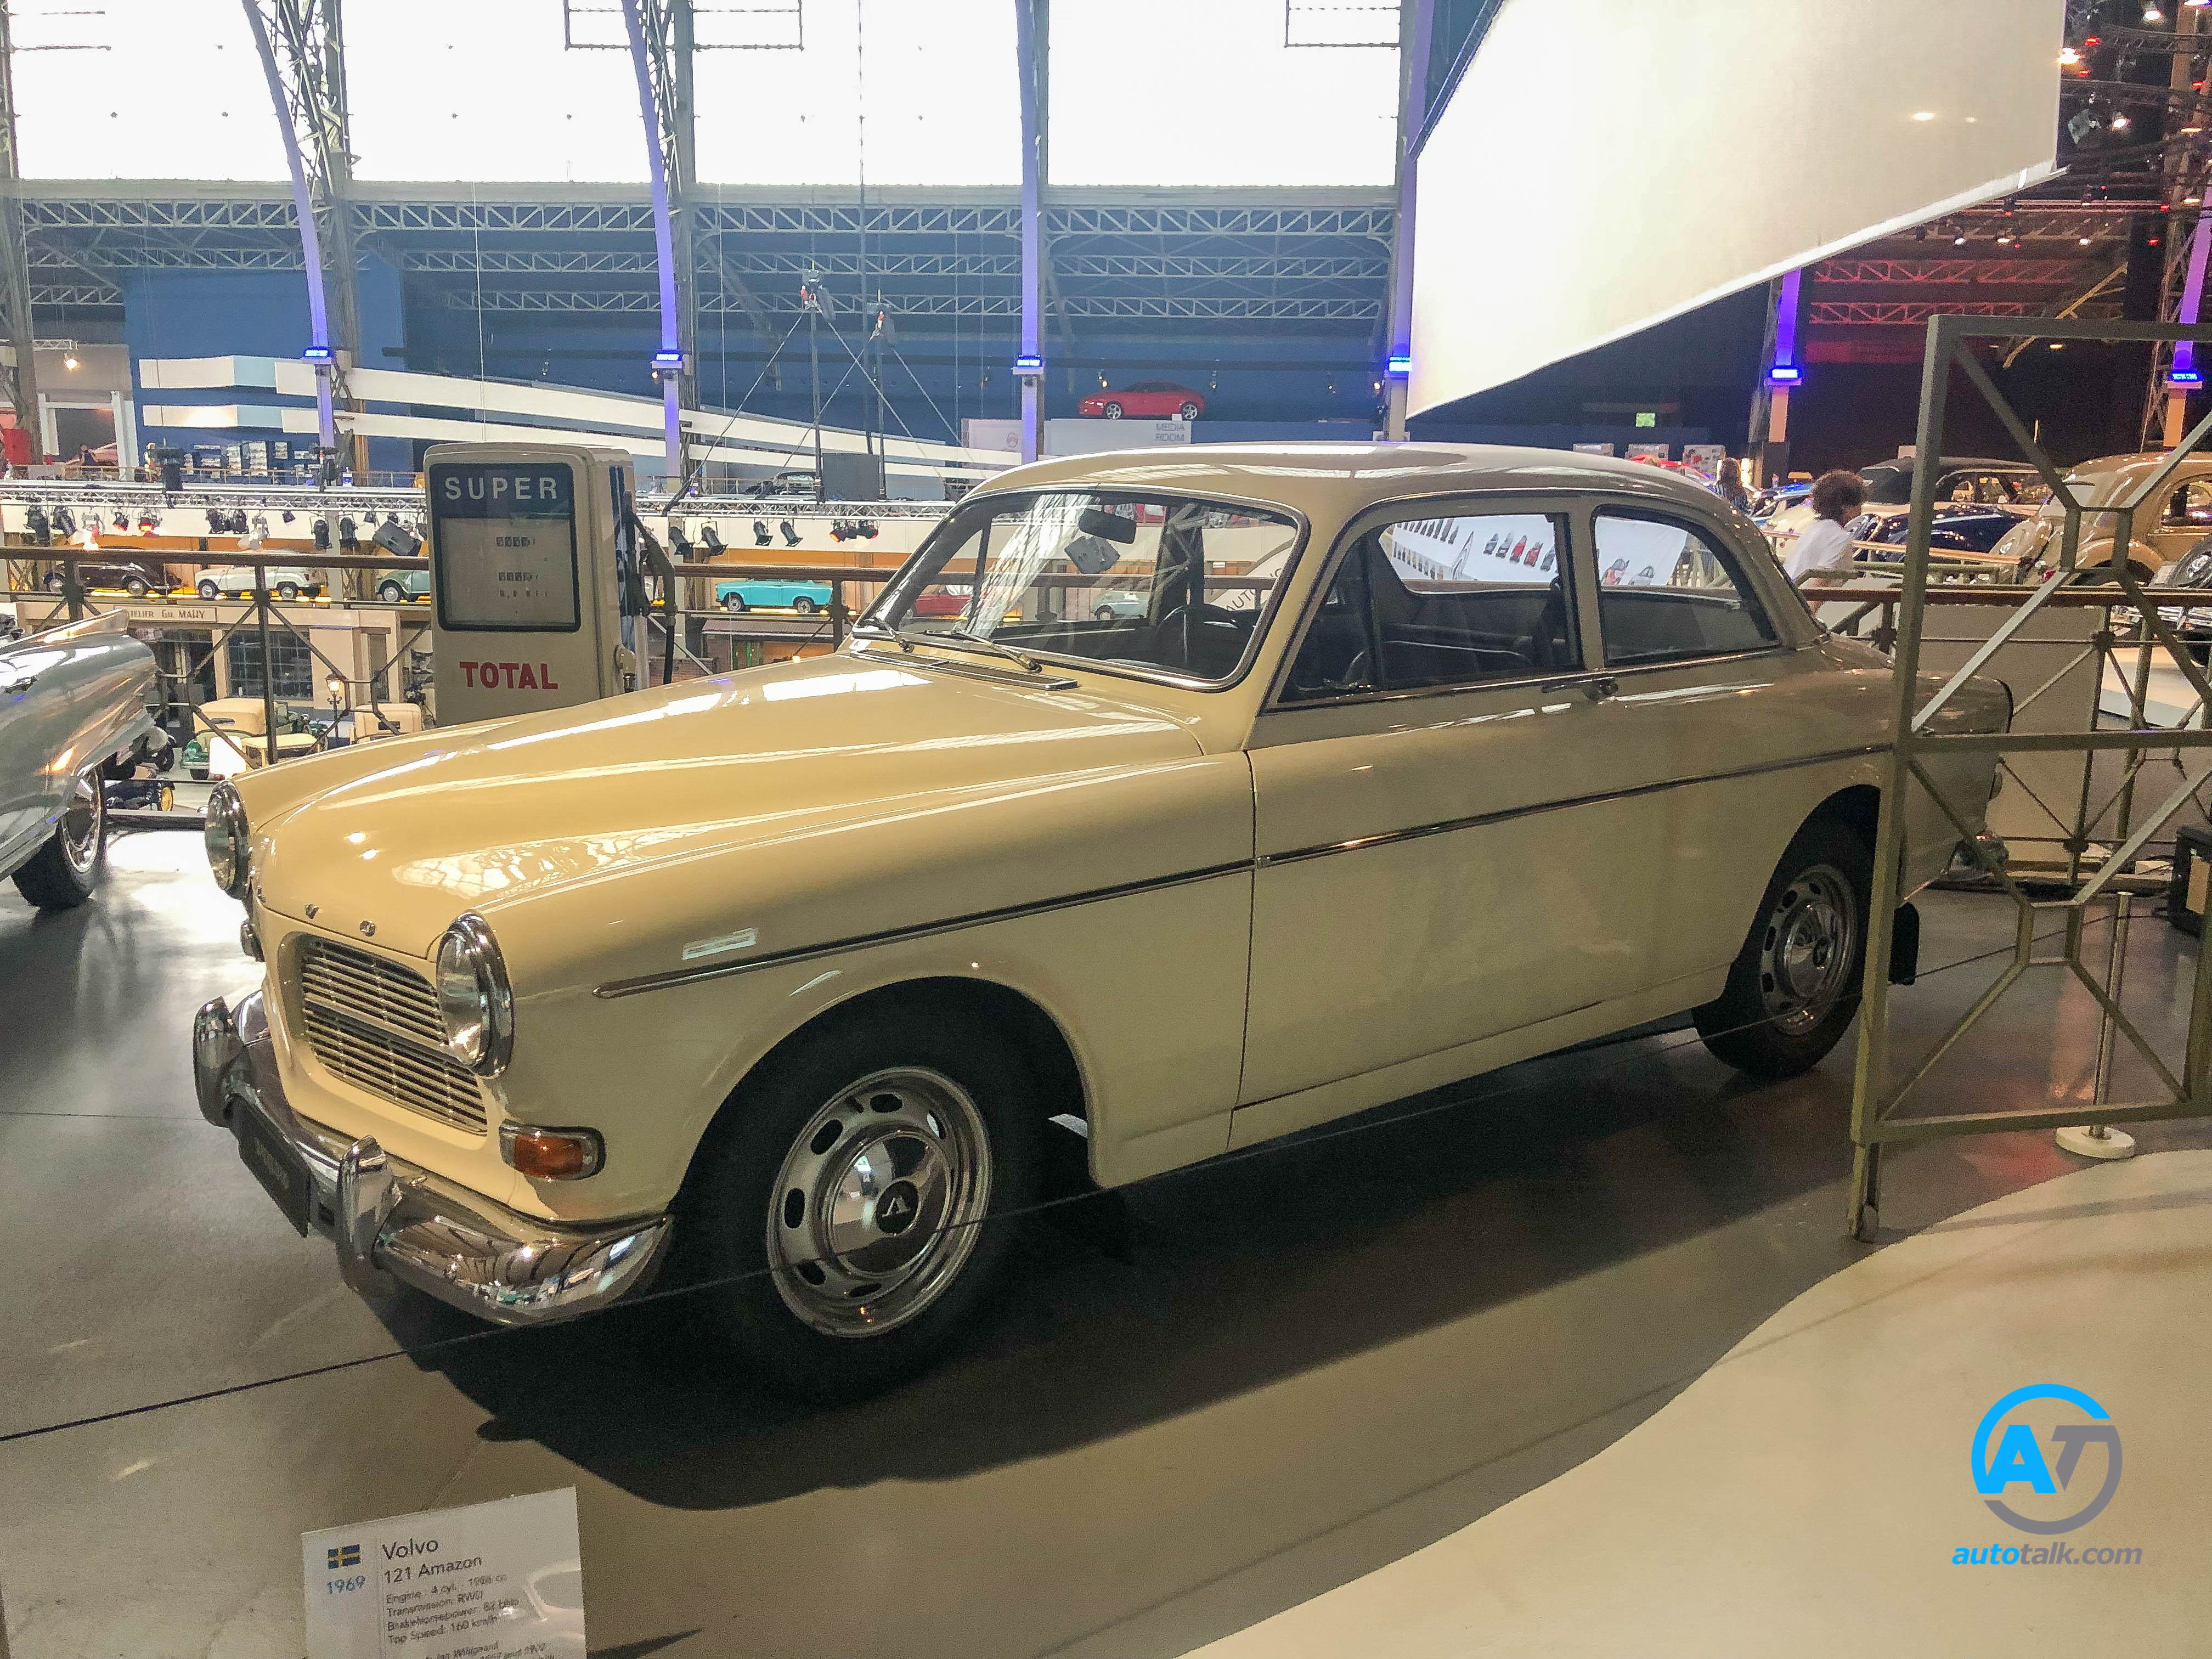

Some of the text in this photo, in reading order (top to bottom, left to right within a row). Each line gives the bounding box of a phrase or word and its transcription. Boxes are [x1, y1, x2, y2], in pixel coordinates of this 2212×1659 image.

[1155, 423, 1186, 431] MEDIA
[1155, 433, 1185, 442] ROOM
[444, 476, 557, 500] SUPER
[459, 661, 558, 690] TOTAL
[381, 1537, 439, 1560] Volvo
[384, 1555, 483, 1584] 121 Amazon
[325, 1575, 366, 1595] 1969
